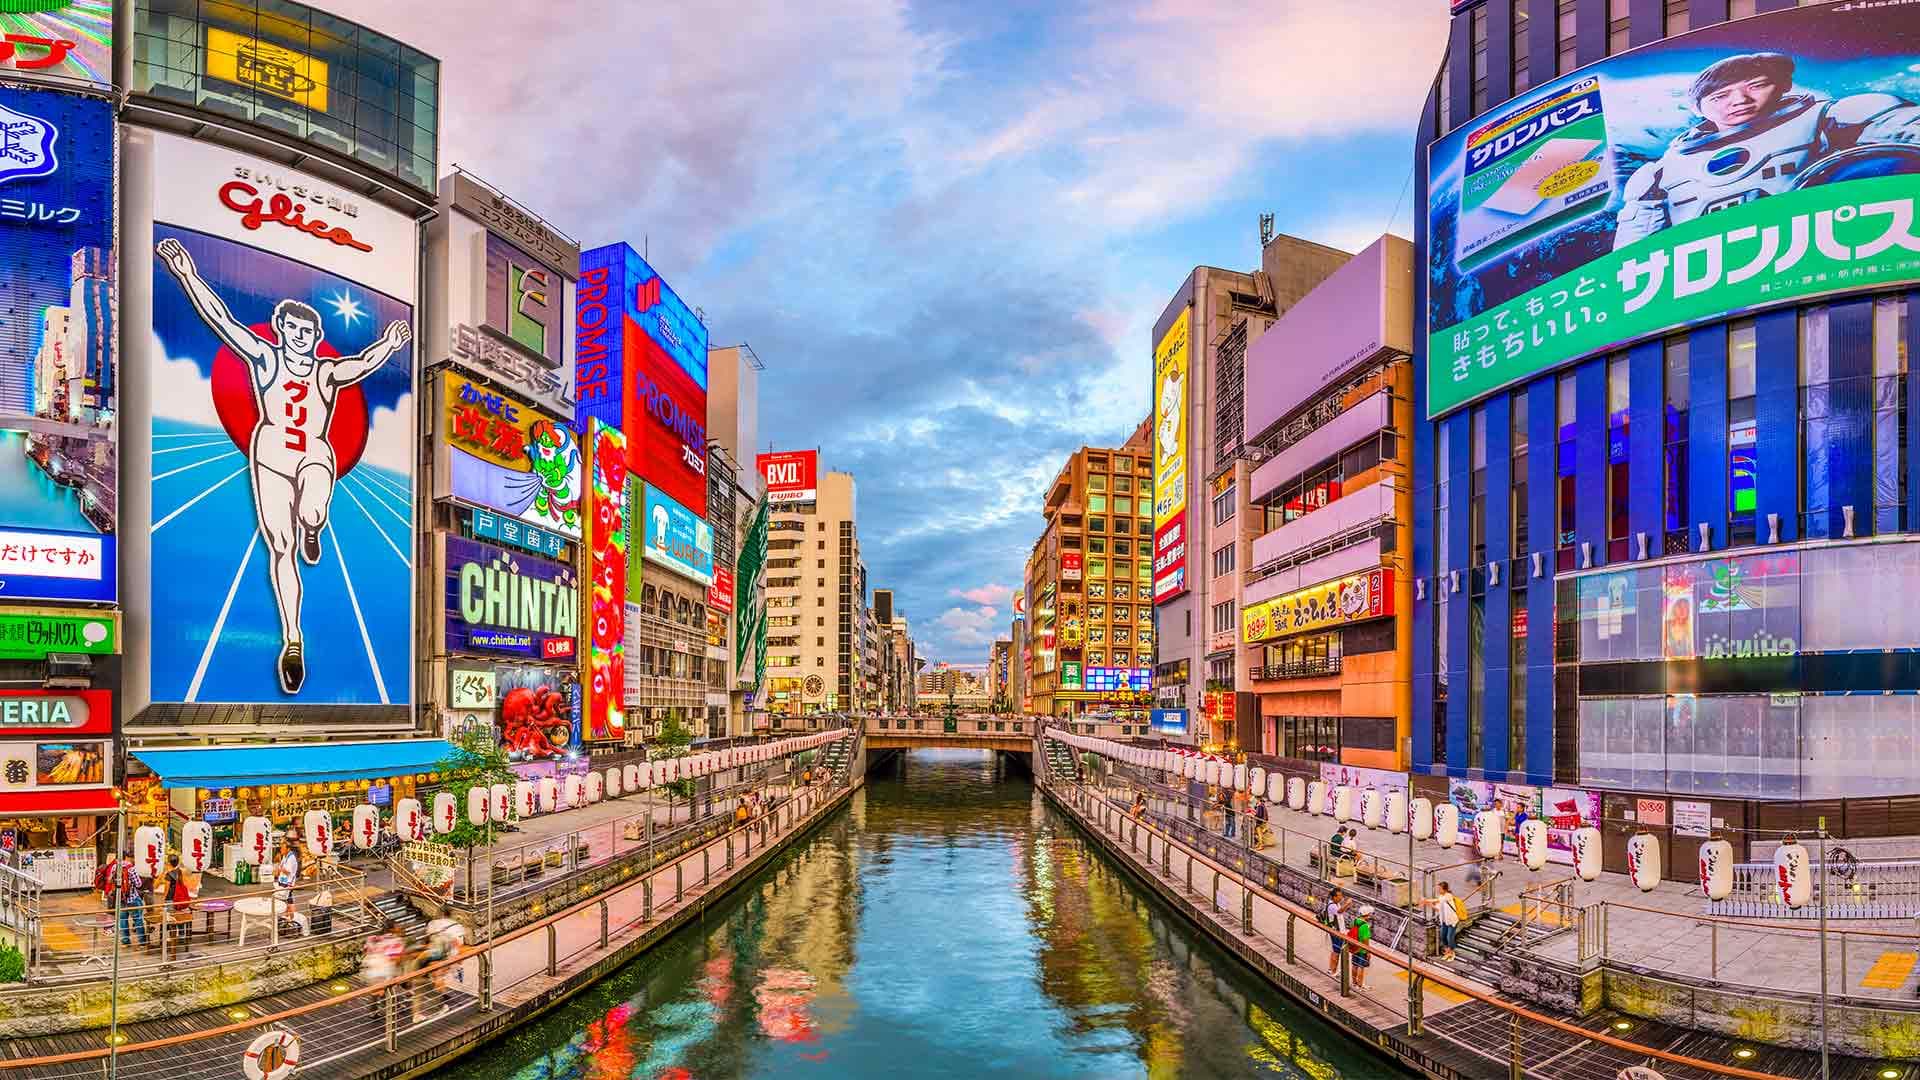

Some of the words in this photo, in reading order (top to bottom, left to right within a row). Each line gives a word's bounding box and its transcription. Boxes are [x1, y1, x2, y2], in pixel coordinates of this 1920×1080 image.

[1574, 79, 1593, 91] 40
[1472, 98, 1594, 168] サロンパス
[1, 198, 80, 223] ミルク
[219, 180, 374, 253] Glico
[1617, 198, 1920, 314] サロンパス
[576, 266, 609, 401] PROMISE
[1452, 308, 1608, 383] きもちいい。
[282, 380, 310, 453] グリコ
[459, 382, 520, 423] かぜに
[636, 369, 706, 457] PROMISE
[681, 444, 705, 476] プロミス
[767, 462, 800, 485] B.V.D.
[1, 544, 95, 566] だけですか
[479, 513, 561, 556] 戸堂歯科
[462, 562, 578, 637] CHINTAI
[1371, 576, 1380, 613] 2F
